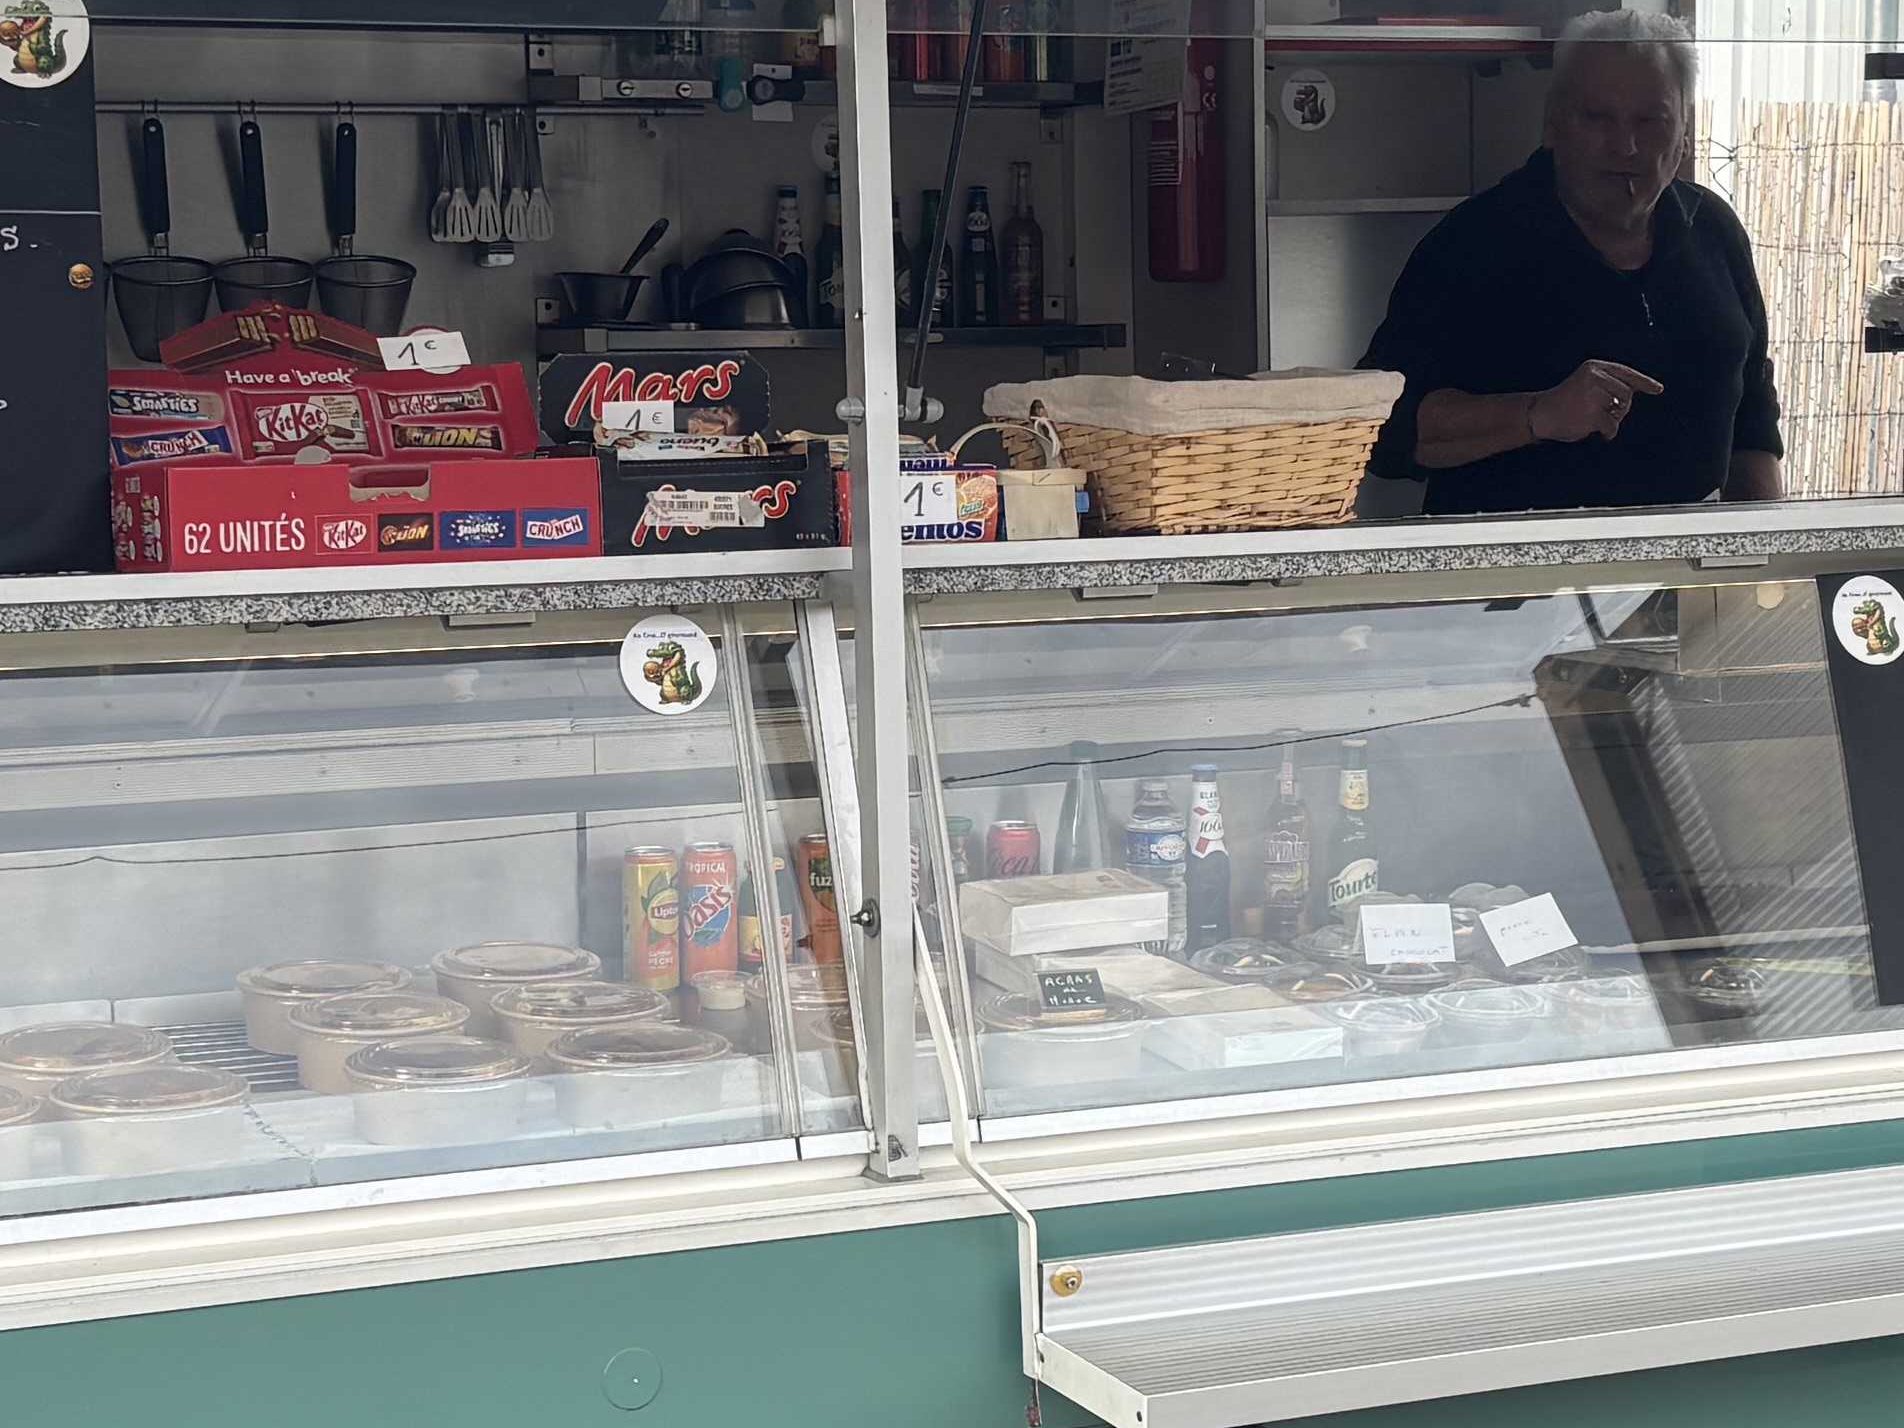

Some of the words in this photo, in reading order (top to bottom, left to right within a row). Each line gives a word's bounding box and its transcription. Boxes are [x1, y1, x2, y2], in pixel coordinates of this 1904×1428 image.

[224, 370, 275, 386] Have
[278, 373, 291, 384] a
[565, 360, 740, 428] Mars
[183, 522, 212, 554] 62
[219, 513, 306, 553] UNITÉS
[528, 517, 582, 538] CRUNCH
